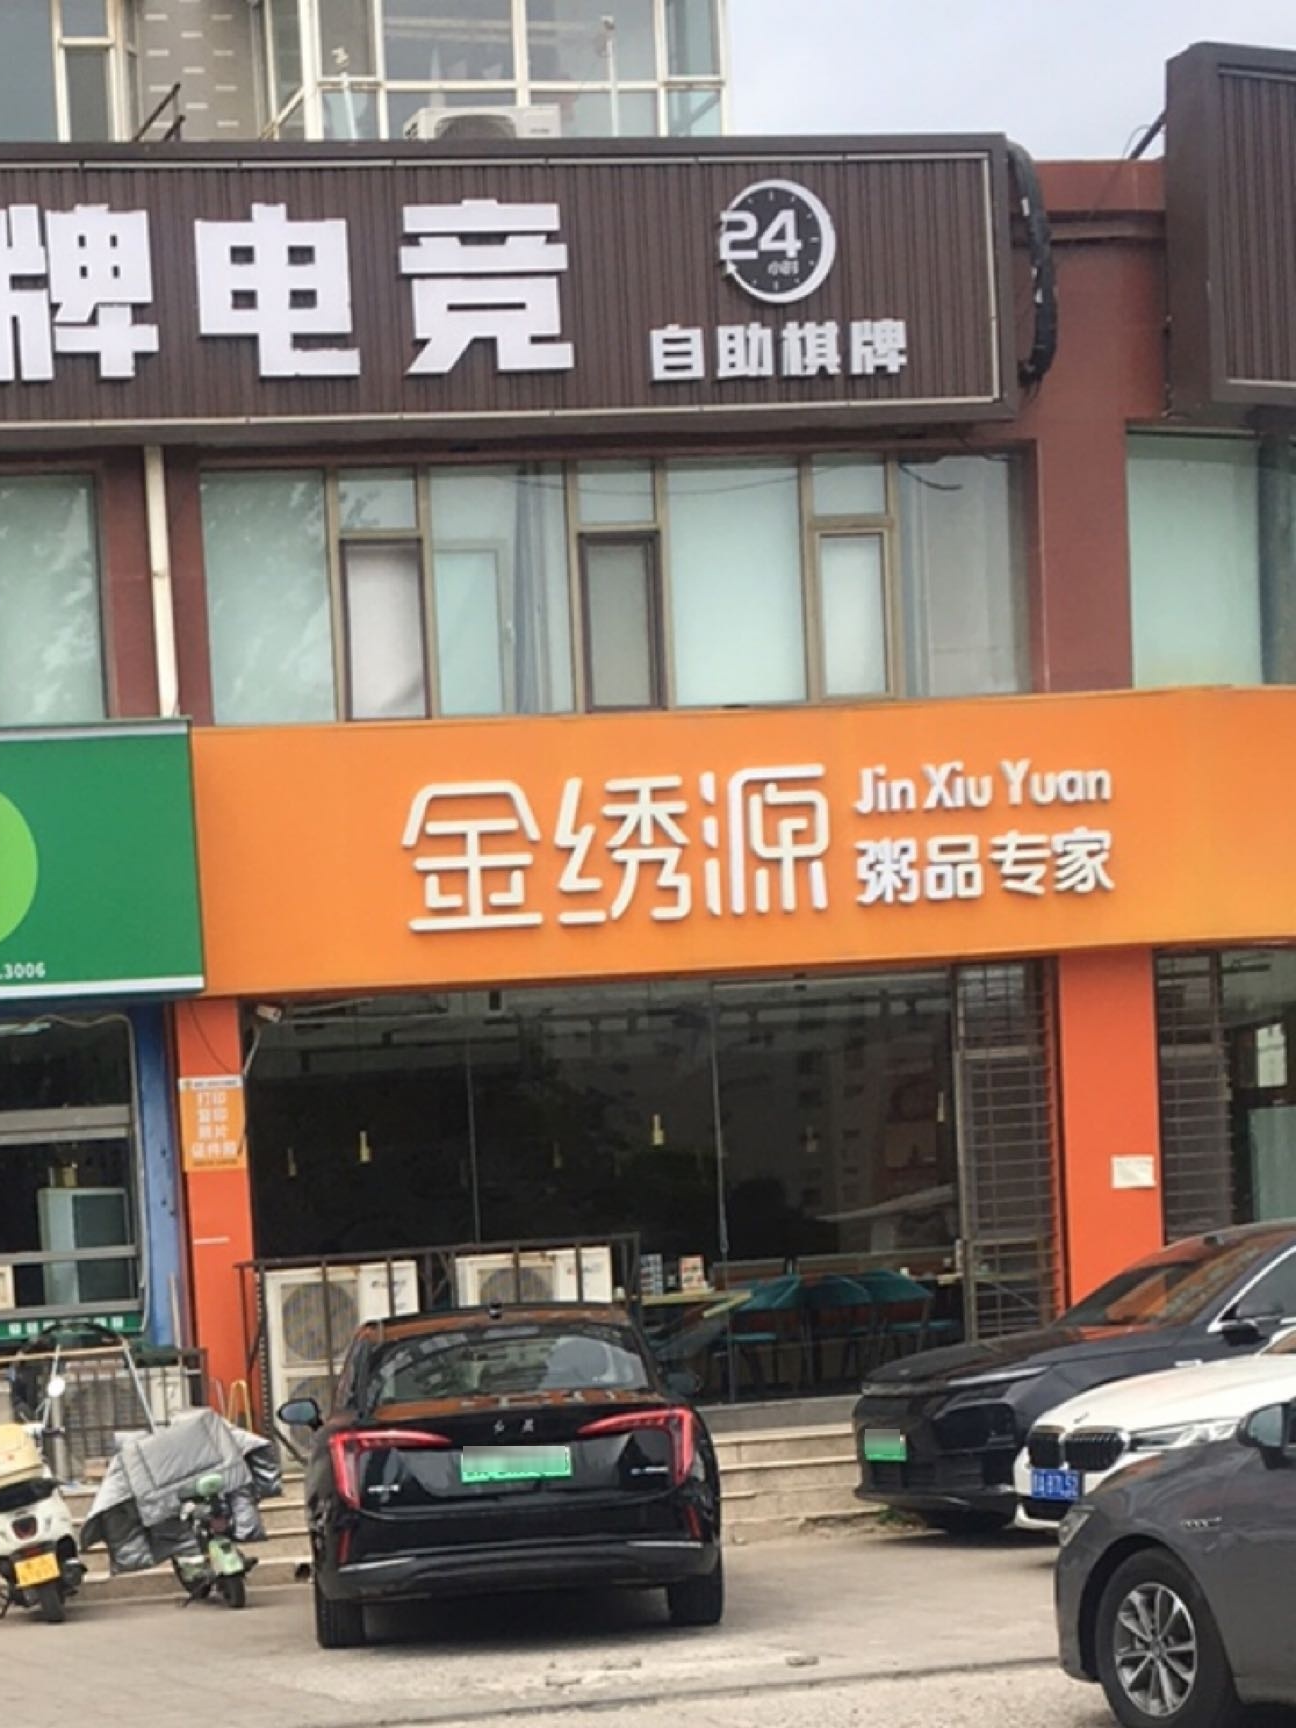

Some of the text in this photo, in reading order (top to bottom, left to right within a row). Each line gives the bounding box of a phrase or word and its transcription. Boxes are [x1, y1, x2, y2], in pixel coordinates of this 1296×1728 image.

[719, 208, 802, 260] 24
[650, 318, 908, 381] 自助棋牌
[855, 757, 1113, 814] Jin Xiu Yuan
[402, 762, 830, 932] 金绣源
[855, 827, 1115, 906] 粥品专家
